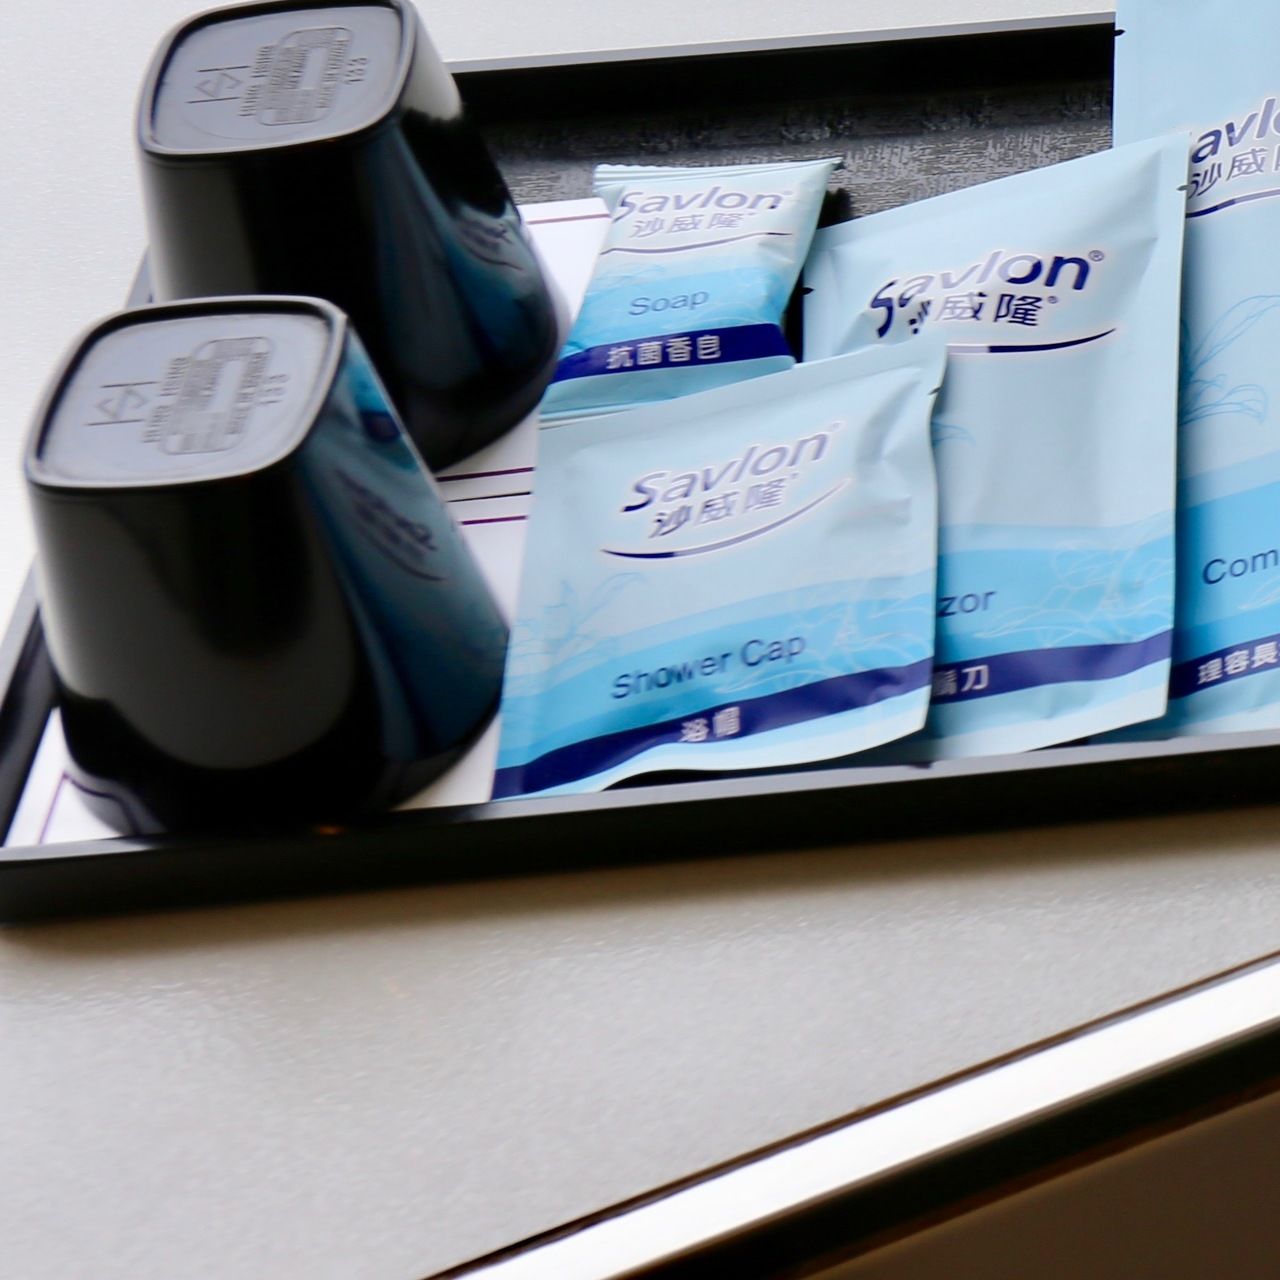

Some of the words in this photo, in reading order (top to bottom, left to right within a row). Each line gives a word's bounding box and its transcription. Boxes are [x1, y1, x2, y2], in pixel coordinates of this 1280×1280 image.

[612, 186, 784, 224] Savlon
[628, 212, 745, 239] 沙威隆
[627, 290, 710, 317] Soap
[870, 249, 1091, 338] Savlon
[605, 333, 722, 370] 抗菌香皂
[622, 432, 829, 513] Savlon
[648, 476, 787, 539] 沙威隆
[936, 589, 997, 619] zor
[610, 651, 734, 700] Shower
[740, 635, 807, 668] Cap
